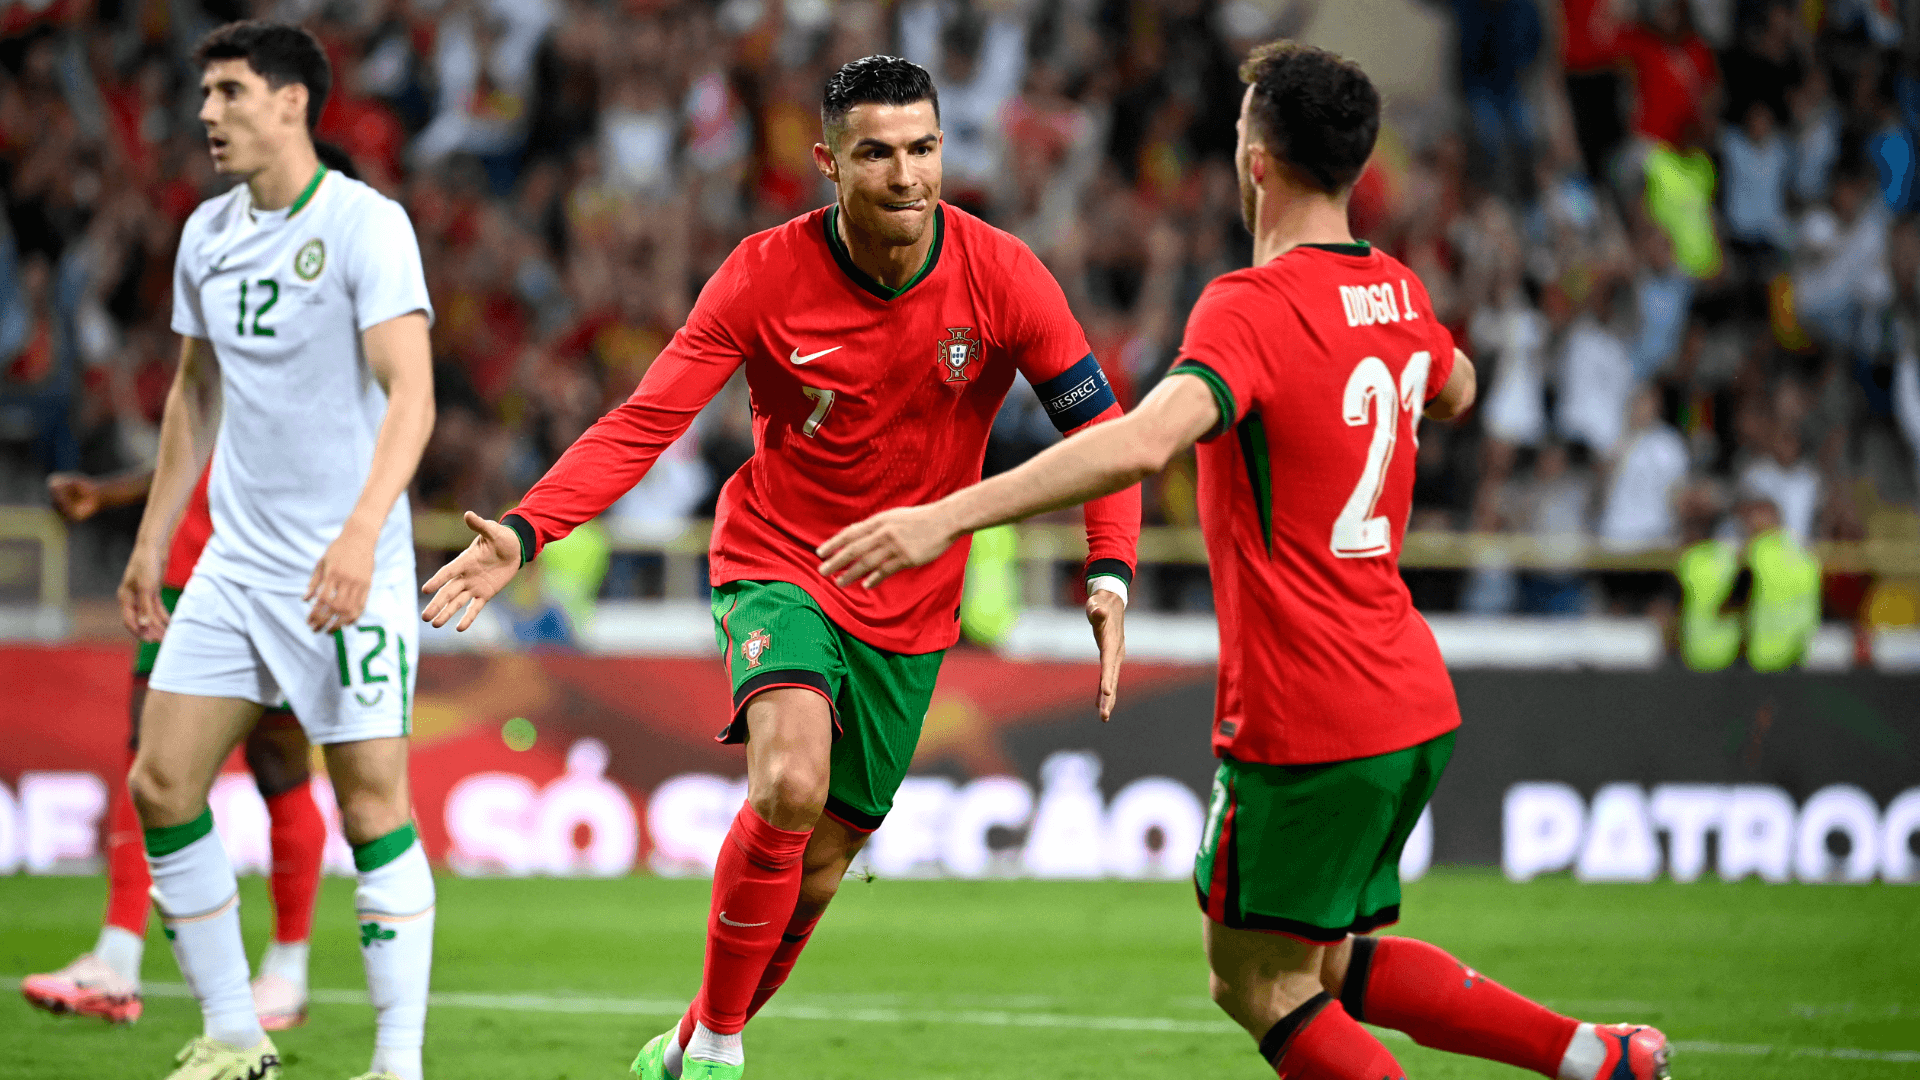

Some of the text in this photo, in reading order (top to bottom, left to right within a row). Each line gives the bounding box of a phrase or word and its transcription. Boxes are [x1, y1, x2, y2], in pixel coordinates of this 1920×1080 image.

[236, 278, 279, 337] 12
[801, 386, 836, 439] 7
[1052, 379, 1097, 410] RESPECT
[1330, 350, 1432, 559] 21
[333, 625, 389, 687] 12
[648, 750, 1204, 879] SEÇÃO
